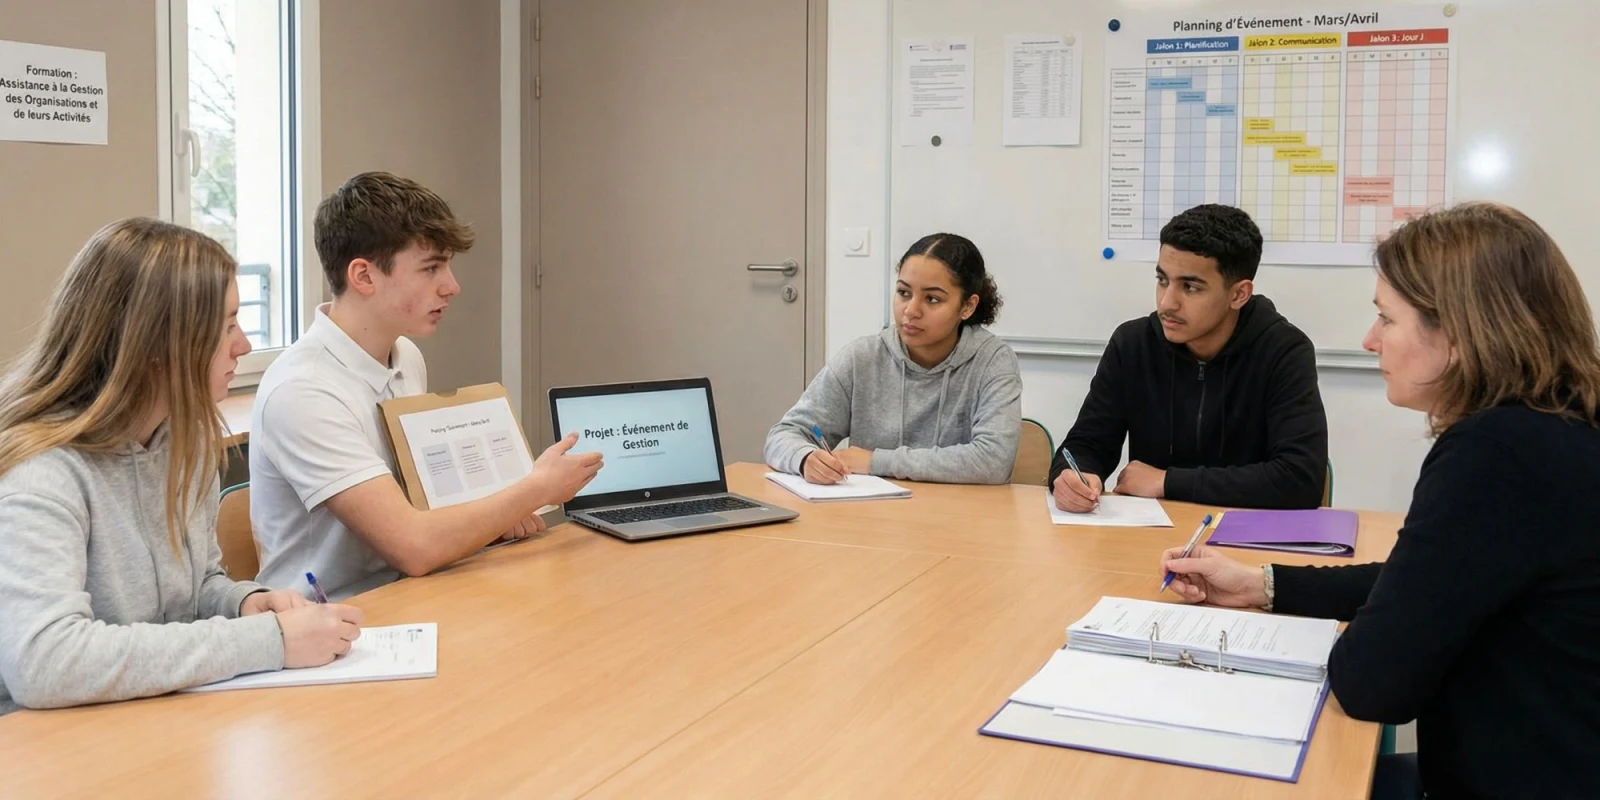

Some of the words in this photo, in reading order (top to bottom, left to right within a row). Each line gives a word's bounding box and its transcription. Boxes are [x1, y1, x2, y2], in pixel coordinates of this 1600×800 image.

[1173, 19, 1222, 32] Planning
[1314, 13, 1379, 26] Mars/Avril
[1248, 38, 1268, 47] Jalon
[1278, 37, 1336, 45] Communication
[1370, 34, 1390, 43] Jalon
[1391, 34, 1400, 42] 3:
[1401, 33, 1419, 42] Jour
[1184, 41, 1229, 49] Planification
[26, 65, 72, 78] Formation
[0, 77, 50, 91] Assistance
[52, 81, 58, 92] à
[59, 82, 68, 93] la
[69, 83, 104, 95] Gestion
[5, 93, 22, 104] des
[25, 94, 87, 107] Organisations
[89, 100, 99, 109] et
[13, 109, 25, 119] de
[27, 109, 51, 121] leurs
[52, 112, 91, 122] Activités
[584, 427, 615, 440] Projet
[622, 423, 675, 436] Événement
[677, 420, 689, 430] de
[622, 437, 660, 450] Gestion
